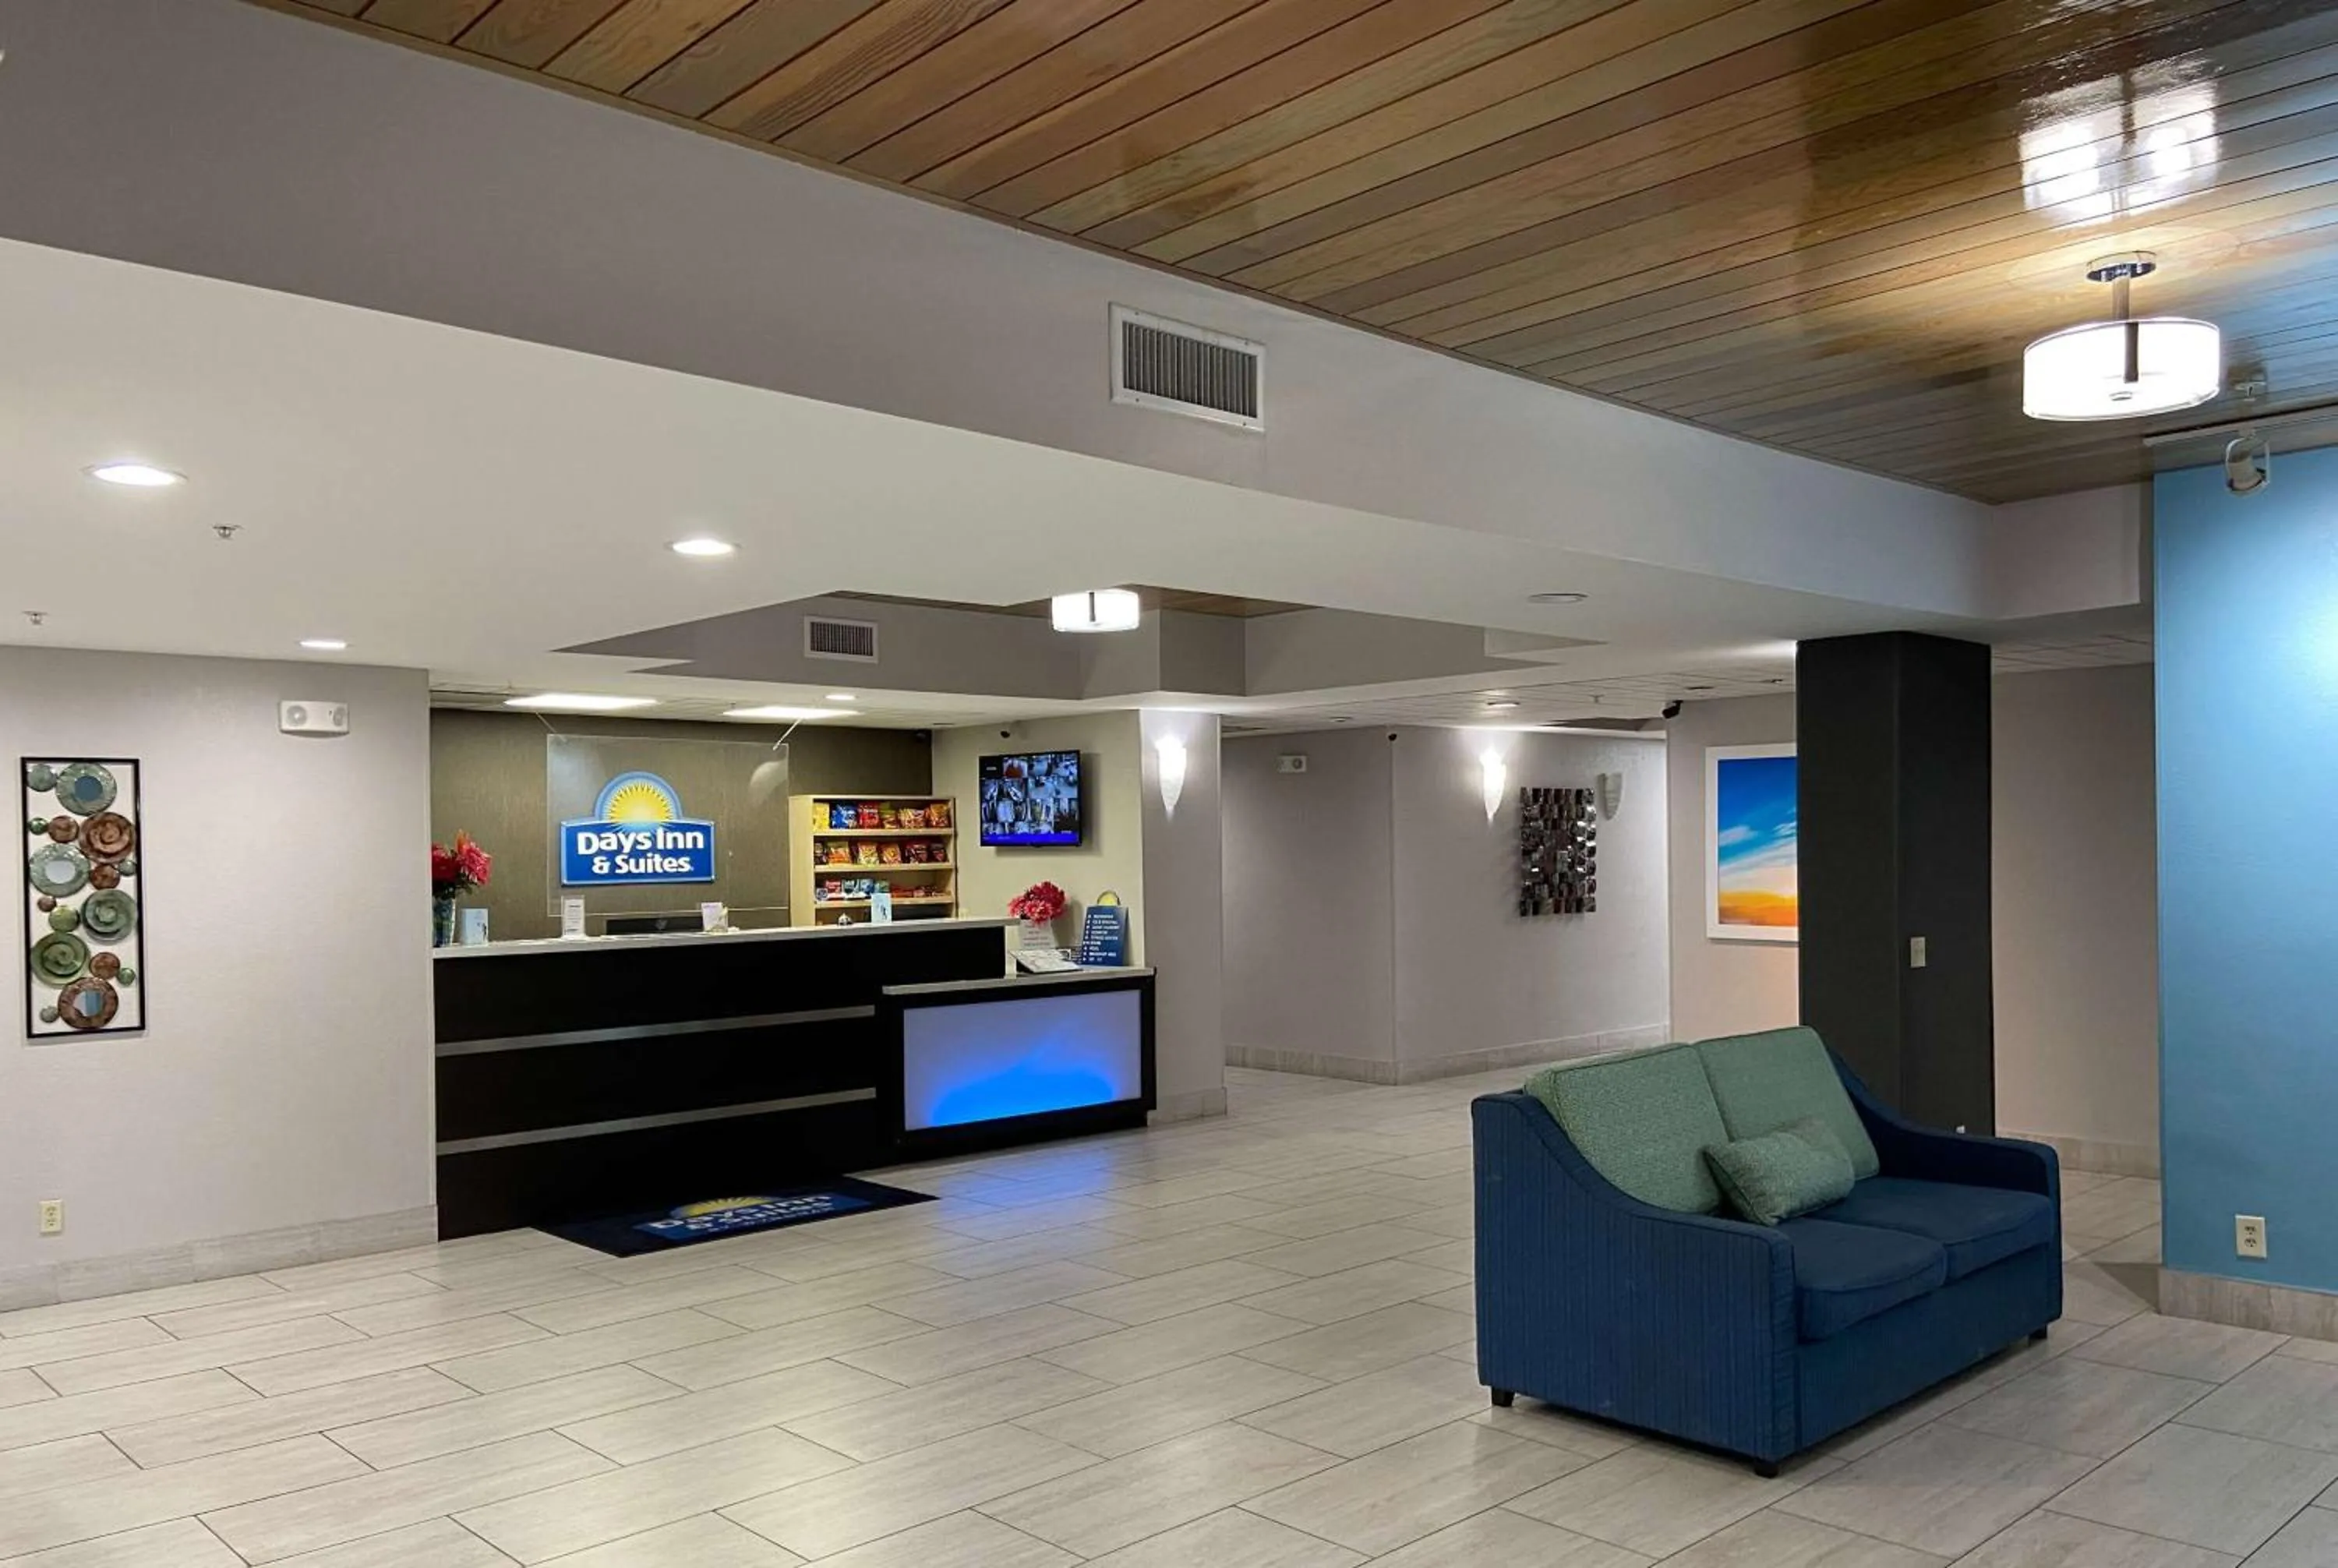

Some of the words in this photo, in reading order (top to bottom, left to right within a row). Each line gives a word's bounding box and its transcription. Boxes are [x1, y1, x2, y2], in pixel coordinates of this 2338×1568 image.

[577, 831, 652, 855] Days
[656, 827, 705, 850] Inn
[592, 856, 610, 874] &
[615, 853, 692, 874] Suites
